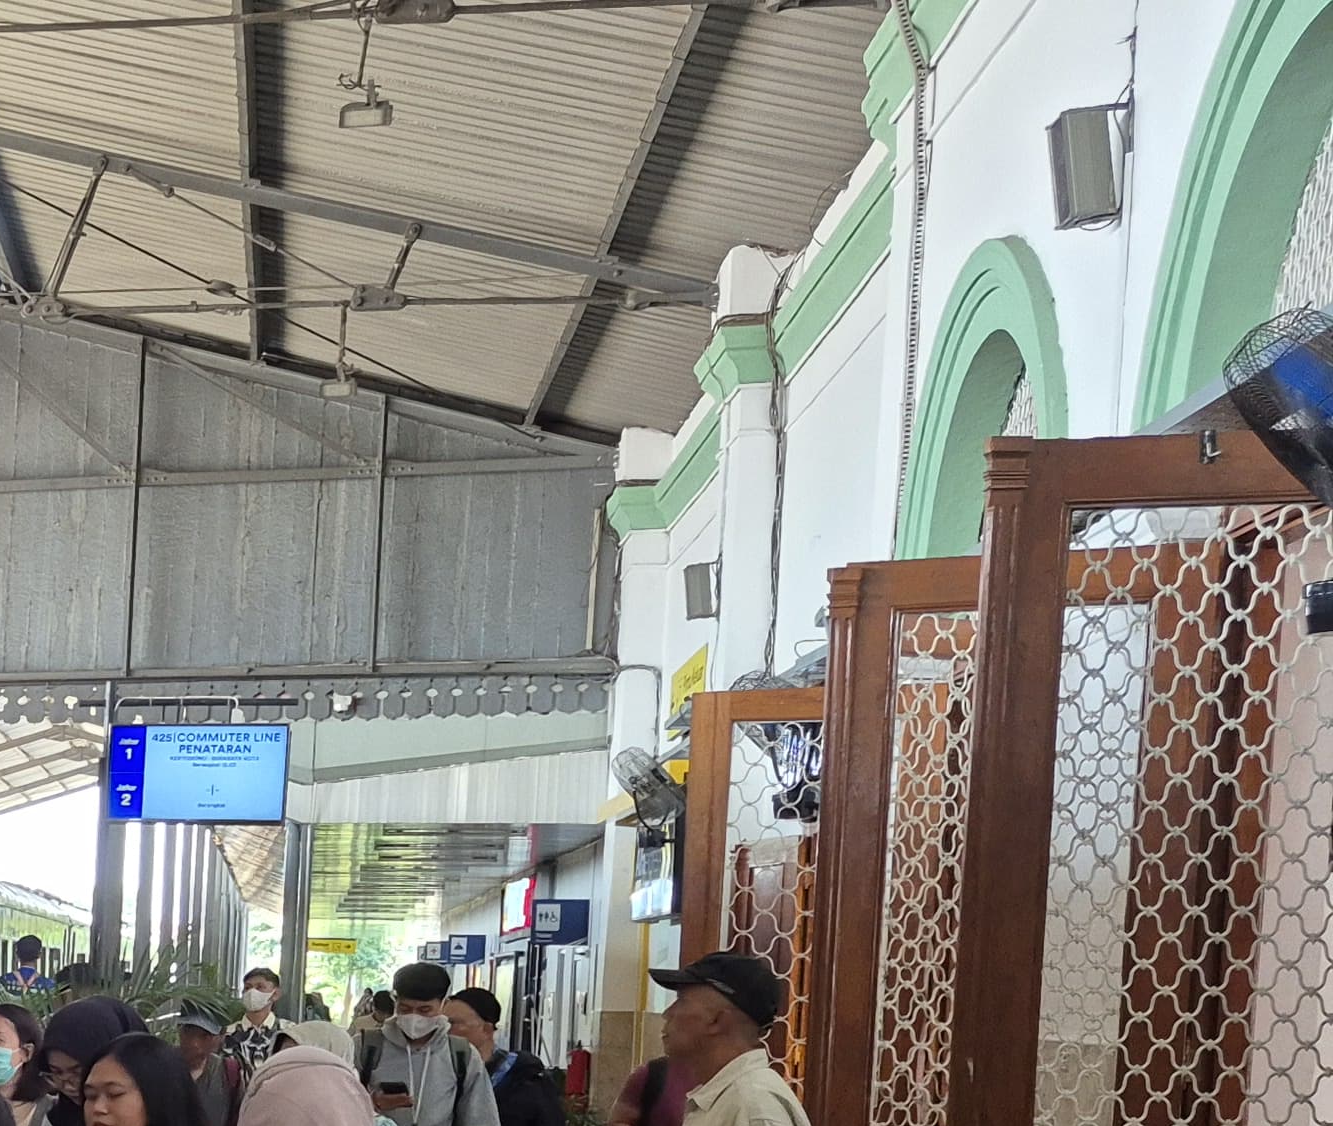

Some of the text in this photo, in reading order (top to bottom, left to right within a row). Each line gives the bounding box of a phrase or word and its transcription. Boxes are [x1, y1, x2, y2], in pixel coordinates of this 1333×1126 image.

[254, 732, 281, 742] LINE
[125, 748, 133, 760] 1
[179, 744, 252, 754] PENATARAN
[120, 793, 132, 806] 2
